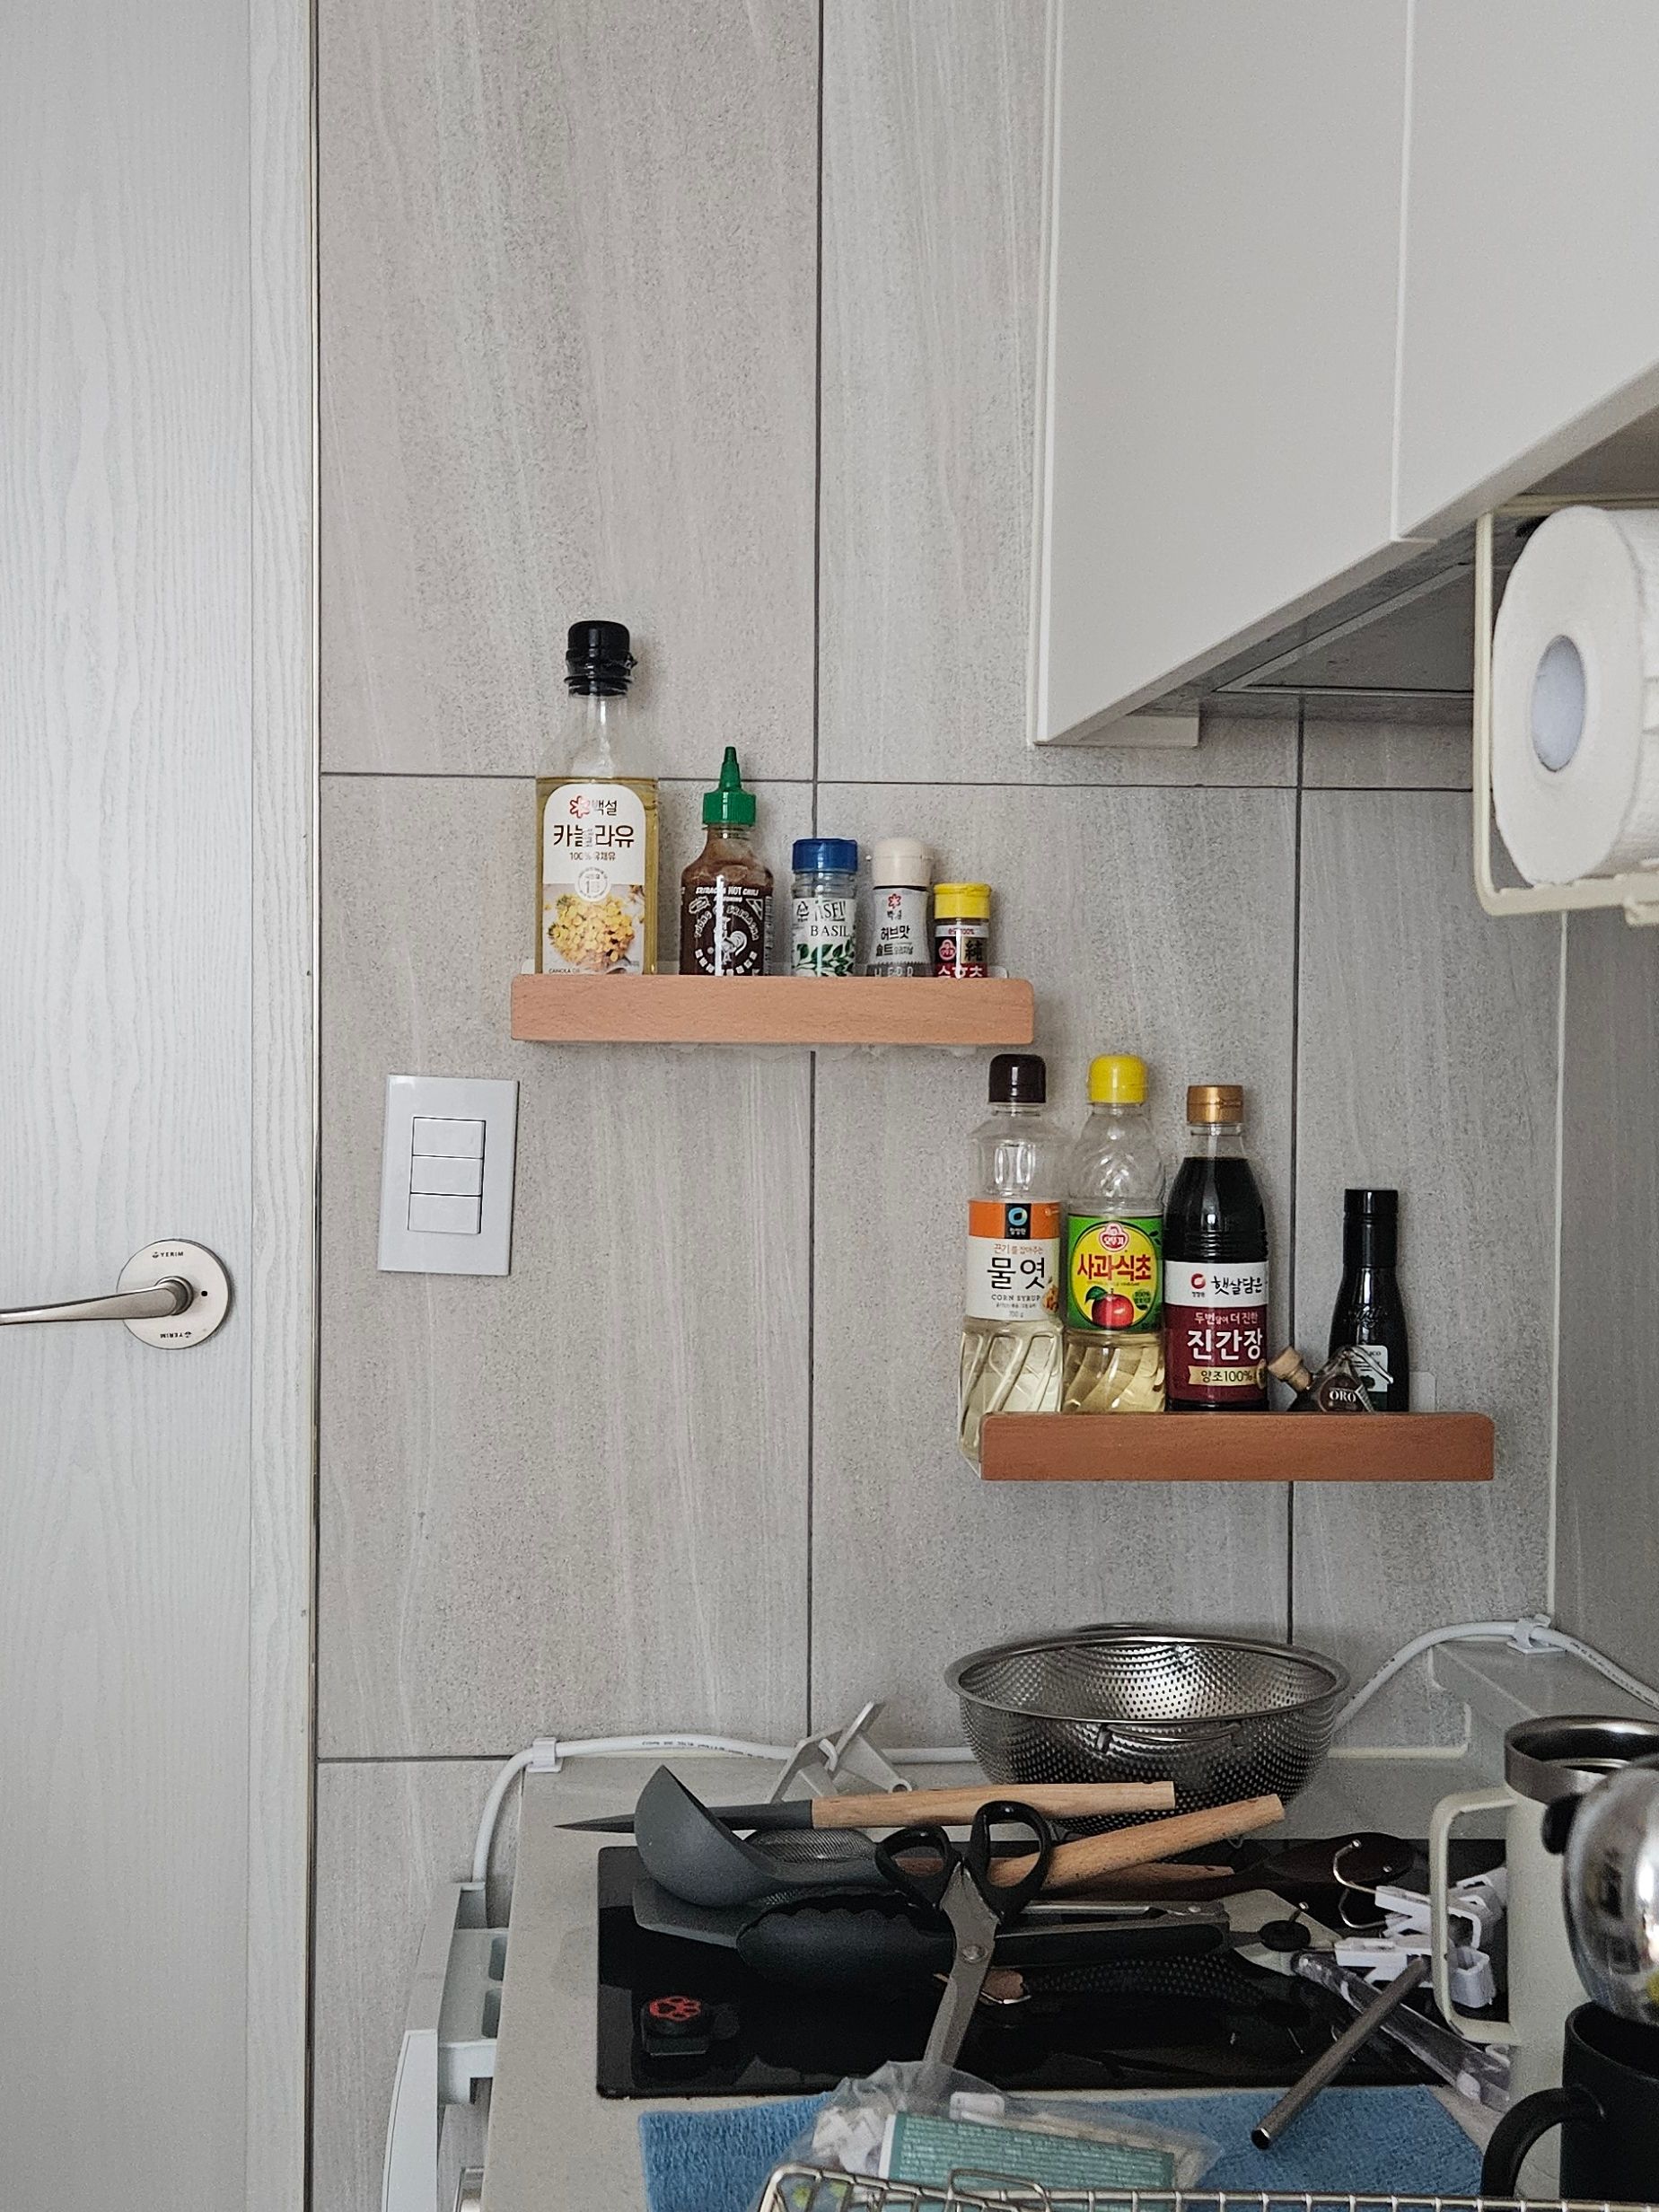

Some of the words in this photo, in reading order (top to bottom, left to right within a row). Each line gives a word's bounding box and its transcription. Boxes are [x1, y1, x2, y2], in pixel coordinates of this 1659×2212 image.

[592, 800, 617, 816] 백설
[696, 887, 726, 895] SRIRACA
[727, 886, 742, 896] HOT
[811, 925, 849, 937] BASIL
[880, 925, 911, 941] 허브맛
[875, 943, 893, 957] 솔트
[986, 1256, 1046, 1290] 물엿
[1076, 1253, 1152, 1282] 사과식초
[1210, 1275, 1263, 1295] 햇살담은
[1230, 1312, 1240, 1325] 더
[1187, 1328, 1264, 1361] 진간장
[1329, 1390, 1356, 1402] ORO
